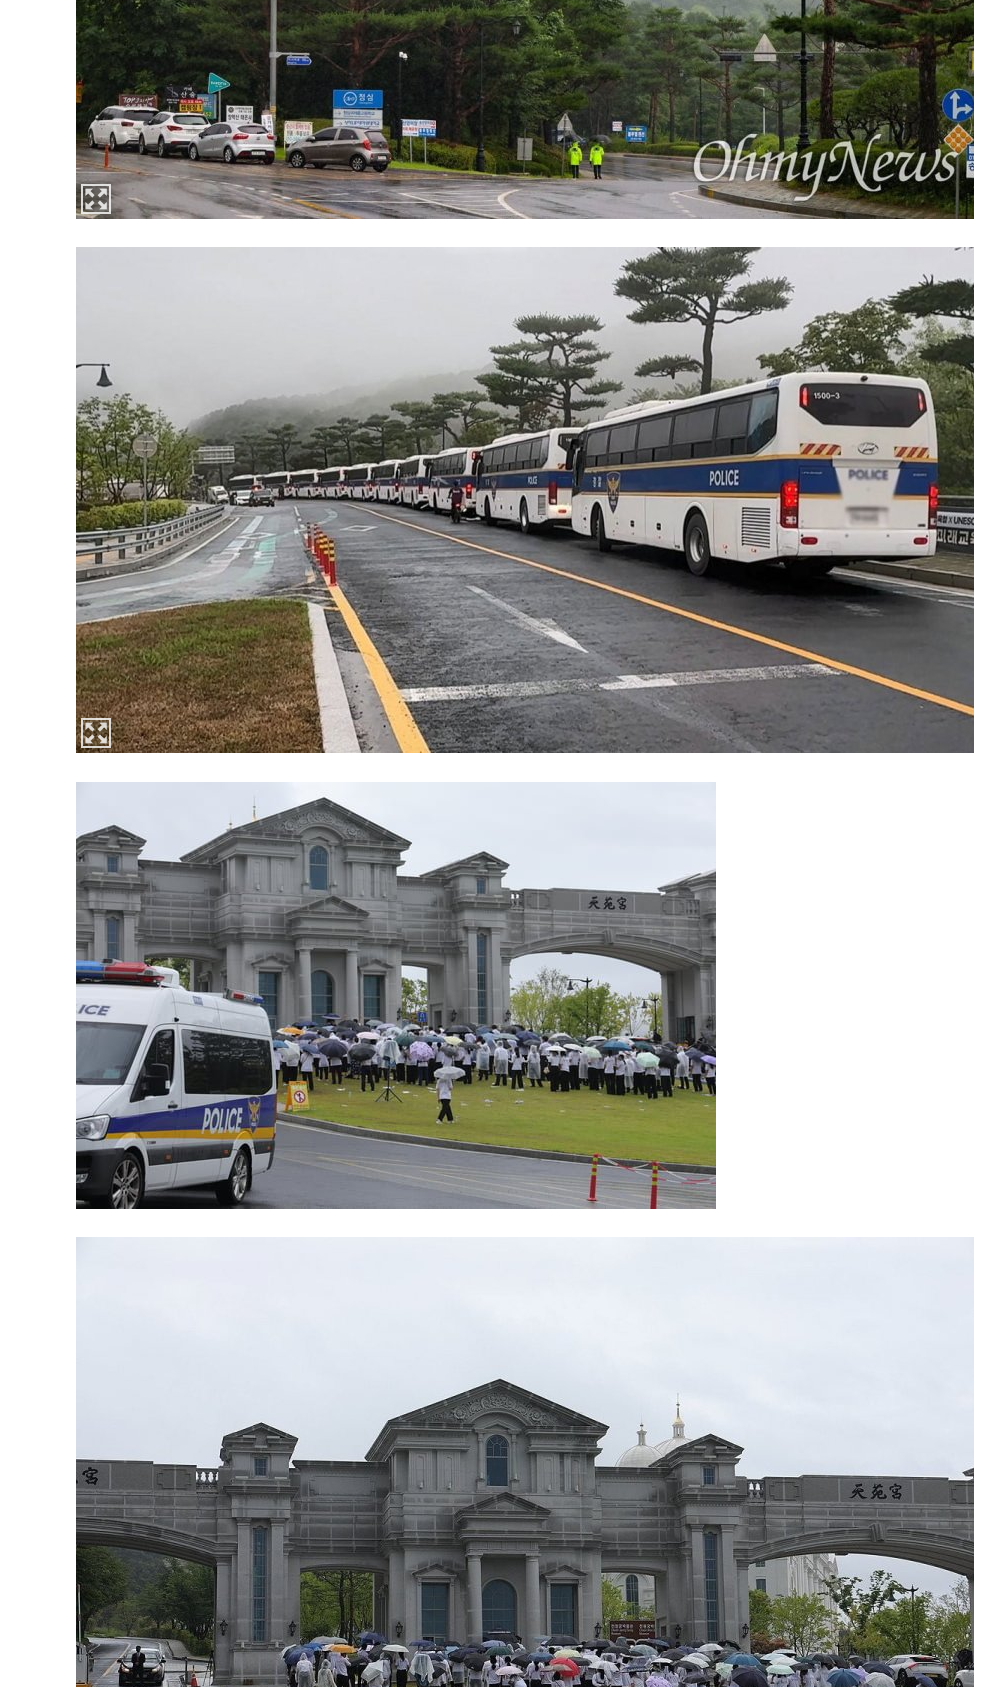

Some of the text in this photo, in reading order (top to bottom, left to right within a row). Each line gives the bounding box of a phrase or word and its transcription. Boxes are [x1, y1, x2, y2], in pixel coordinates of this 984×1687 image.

[813, 392, 841, 400] 1500-3
[709, 469, 739, 486] POLICE
[848, 469, 889, 482] POLICE
[201, 1107, 243, 1134] POLICE
